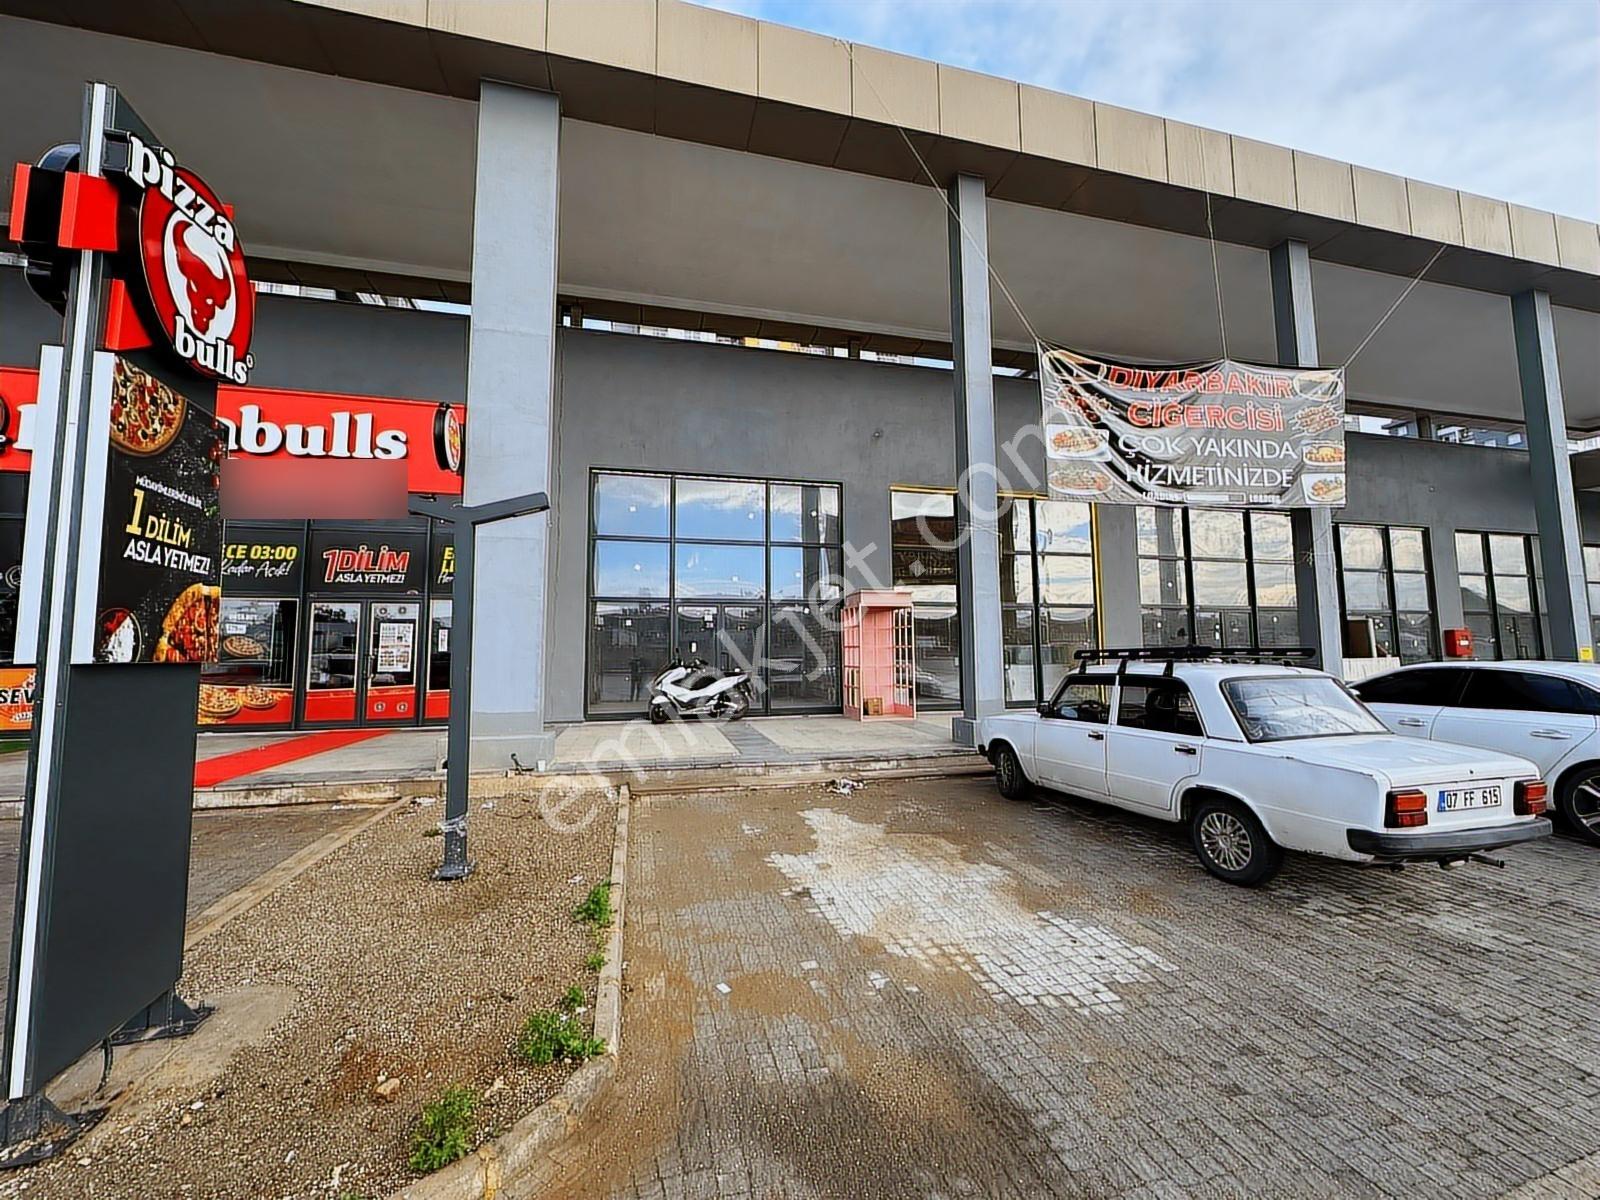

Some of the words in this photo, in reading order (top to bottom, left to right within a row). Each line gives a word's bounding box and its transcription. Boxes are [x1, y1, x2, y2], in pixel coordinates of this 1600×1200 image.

[127, 131, 236, 252] pizza
[174, 315, 249, 384] bulls
[1118, 434, 1186, 459] ÇOK
[1190, 436, 1298, 460] YAKINDA
[1126, 459, 1294, 488] HİZMETİNİZDE
[125, 488, 145, 535] 1
[145, 512, 192, 548] DİLİM
[123, 538, 162, 566] ASLA
[164, 546, 211, 575] YETMEZ!
[223, 544, 247, 559] CE
[250, 544, 297, 560] 03:00
[337, 544, 410, 573] DİLİM
[335, 573, 362, 583] ASLA
[362, 573, 405, 584] YETMEZ!
[1446, 792, 1458, 808] 07
[1464, 791, 1475, 806] FF
[1482, 788, 1498, 805] 615
